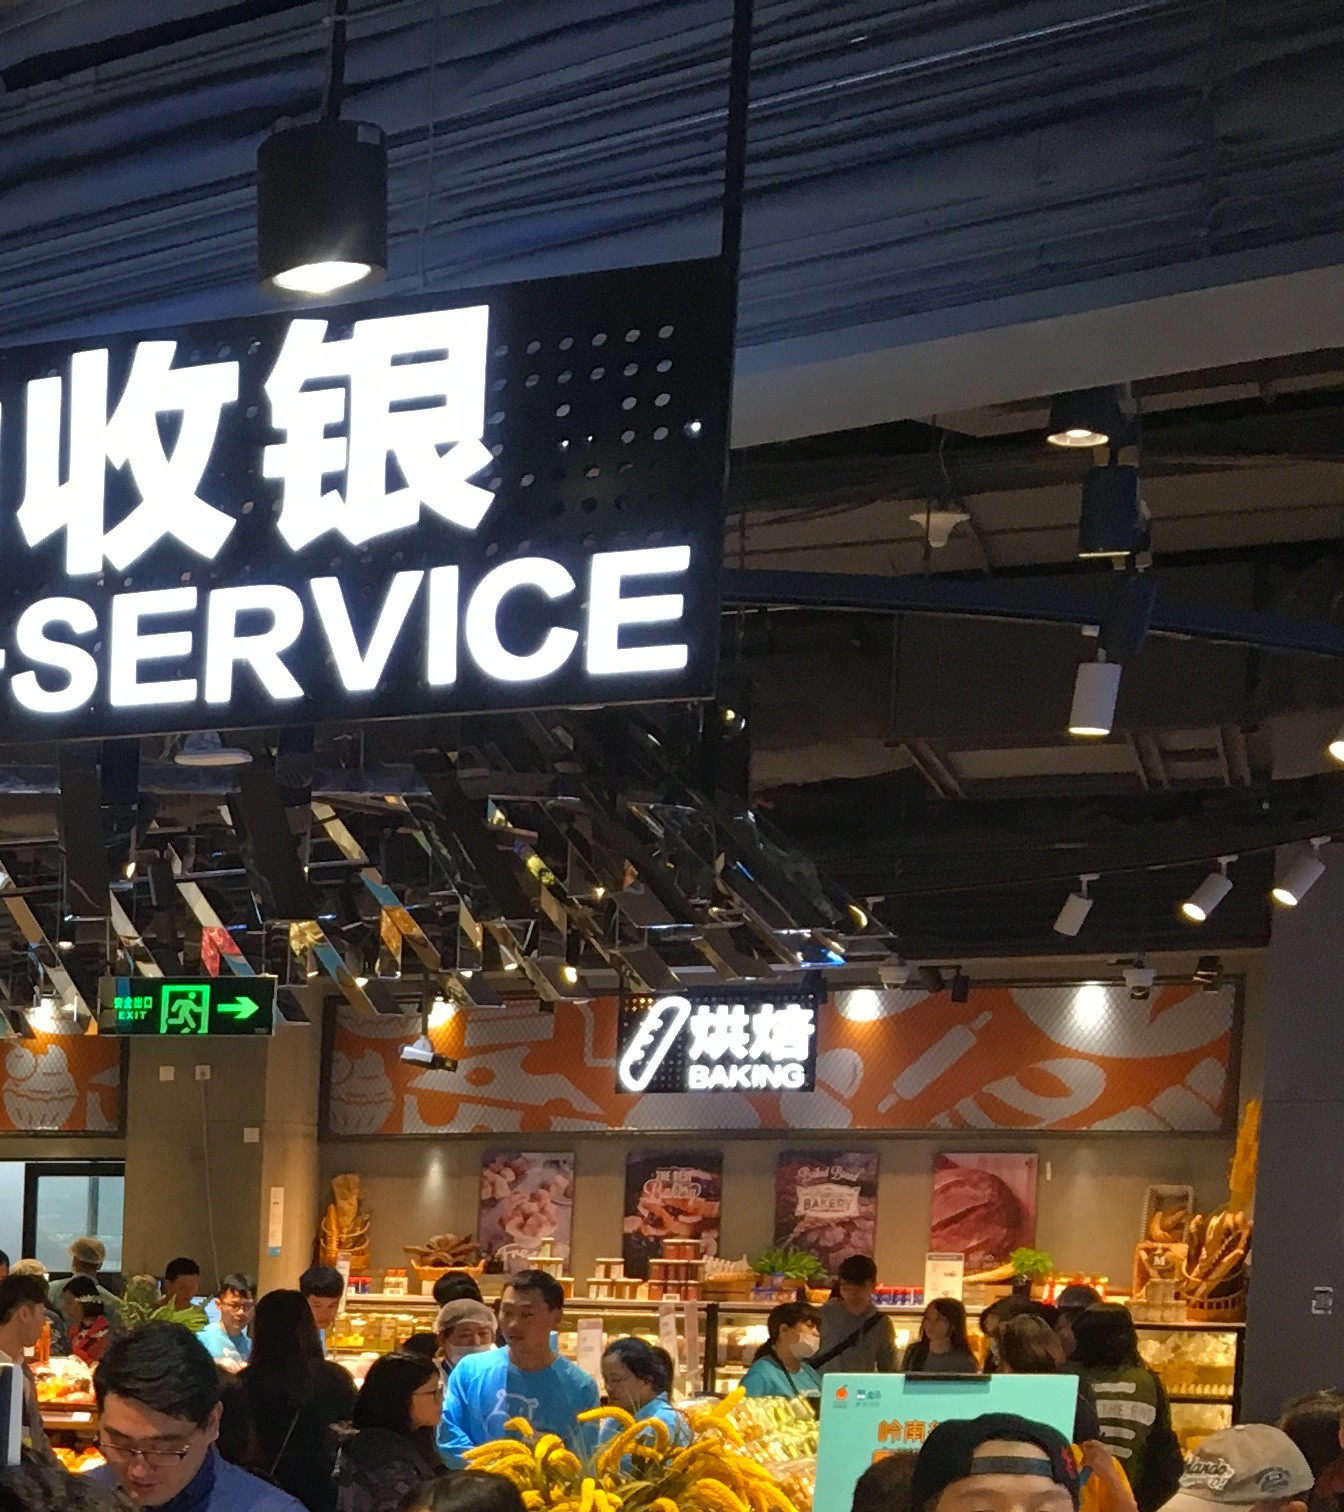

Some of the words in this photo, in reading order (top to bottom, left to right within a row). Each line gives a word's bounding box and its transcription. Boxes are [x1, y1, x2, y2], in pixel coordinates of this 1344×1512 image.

[114, 997, 153, 1009] 安全出口
[118, 1011, 147, 1020] EXIT
[688, 1004, 815, 1060] 烘焙
[688, 1063, 806, 1089] BAKING
[803, 1198, 853, 1210] BAKERY
